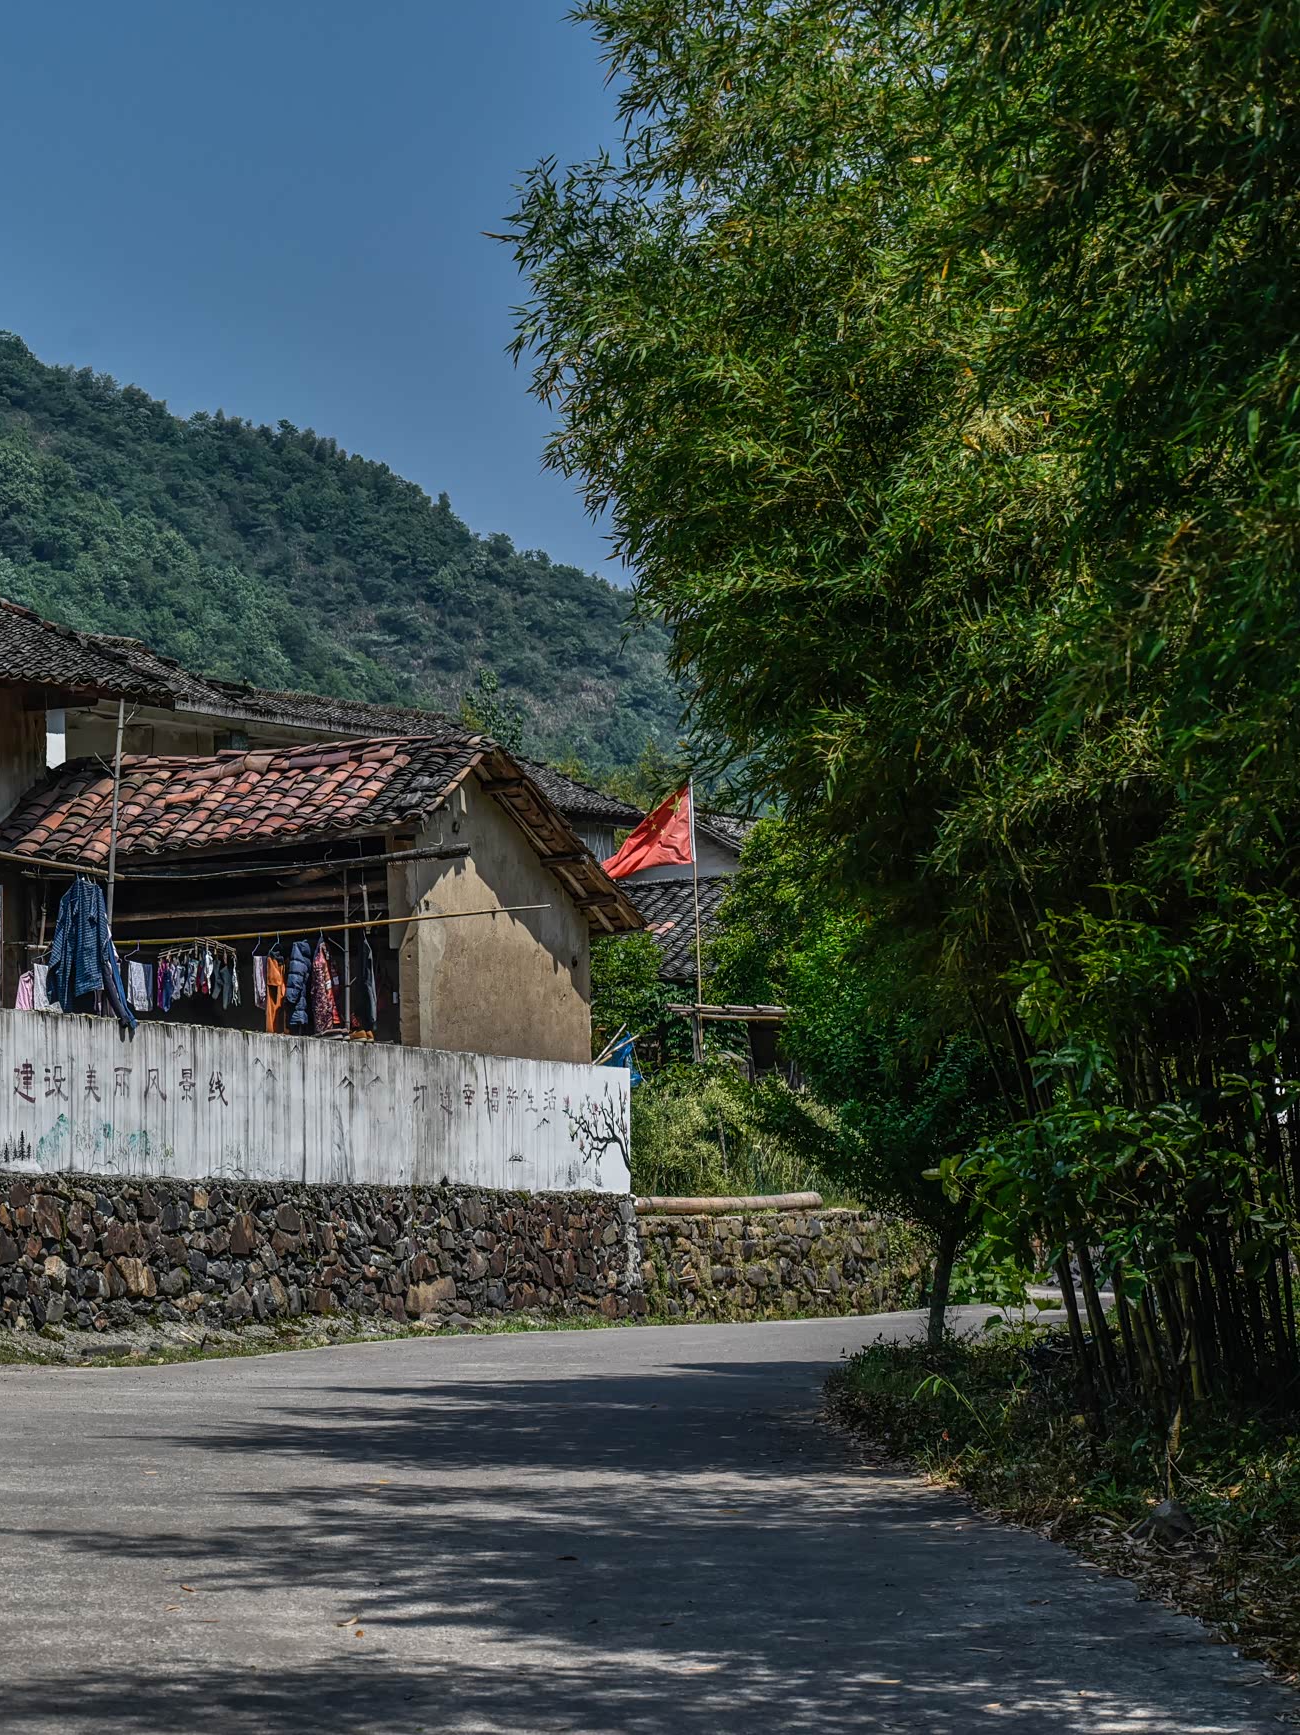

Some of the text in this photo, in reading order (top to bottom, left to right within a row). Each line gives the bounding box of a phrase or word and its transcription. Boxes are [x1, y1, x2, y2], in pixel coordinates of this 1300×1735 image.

[13, 1058, 229, 1107] 建设美丽风景线
